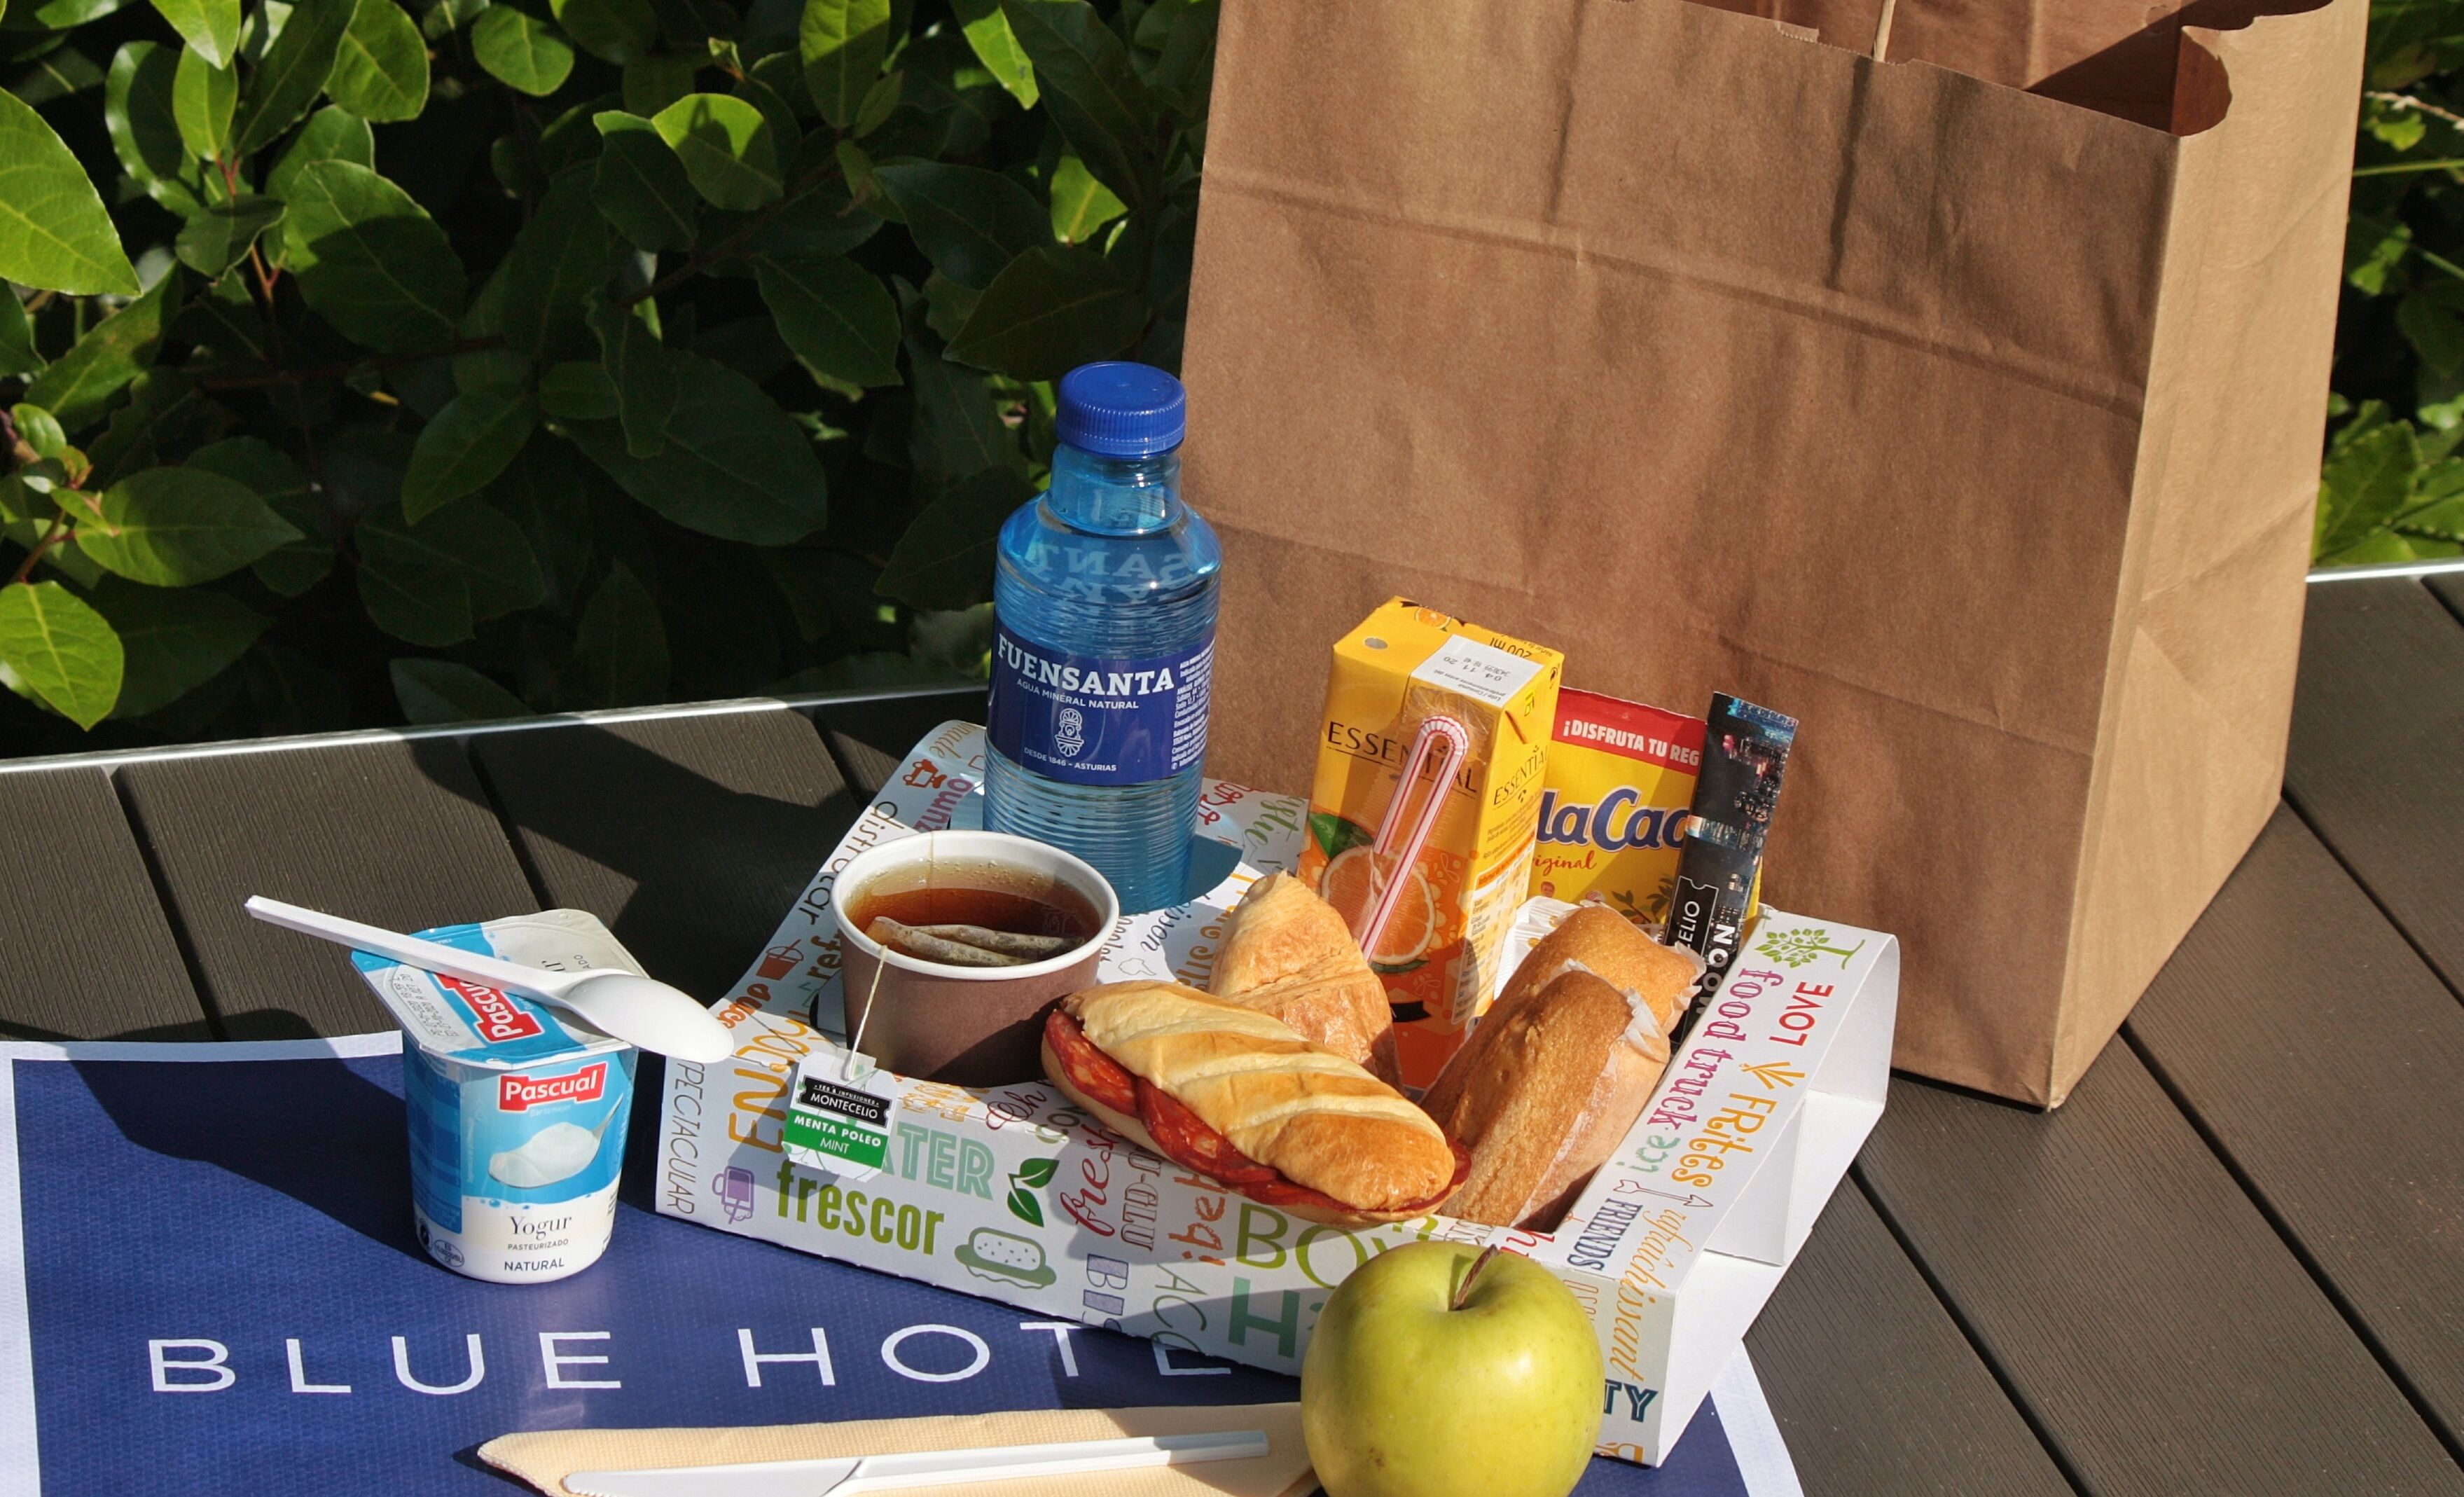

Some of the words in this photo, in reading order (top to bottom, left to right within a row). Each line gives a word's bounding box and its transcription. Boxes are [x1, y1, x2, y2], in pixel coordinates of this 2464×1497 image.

[998, 633, 1174, 696] FUENSANTA
[1017, 678, 1039, 694] AGUA
[1042, 689, 1086, 707] MINERAL
[1088, 701, 1139, 709] NATURAL
[1024, 747, 1046, 761] DESDE
[1048, 757, 1067, 767] 1846
[1074, 763, 1116, 771] ASTURIAS
[1563, 719, 1644, 752] ¡DISFRUTA
[1648, 738, 1667, 757] TU
[1670, 744, 1700, 767] REG
[1494, 744, 1549, 805] ESSENTIAL
[913, 778, 974, 832] zumo
[1702, 967, 1785, 1042] food
[1769, 981, 1835, 1047] LOVE
[506, 1071, 599, 1101] Pascual
[810, 1092, 878, 1119] MONTECELIO
[839, 1089, 876, 1105] INFUSIONES
[1646, 1047, 1733, 1131] truck
[794, 1115, 837, 1136] MENTA
[841, 1126, 882, 1147] POLEO
[820, 1137, 850, 1156] MINT
[1615, 1134, 1681, 1175] ice
[883, 1122, 995, 1201] TER
[1060, 1123, 1122, 1238] fresh
[508, 1215, 572, 1241] Yogur
[776, 1160, 946, 1256] frescor
[508, 1239, 569, 1251] PASTEURIZADO
[1567, 1197, 1644, 1272] FRIENDS
[504, 1257, 565, 1271] NATURAL
[148, 1330, 621, 1394] BLUE
